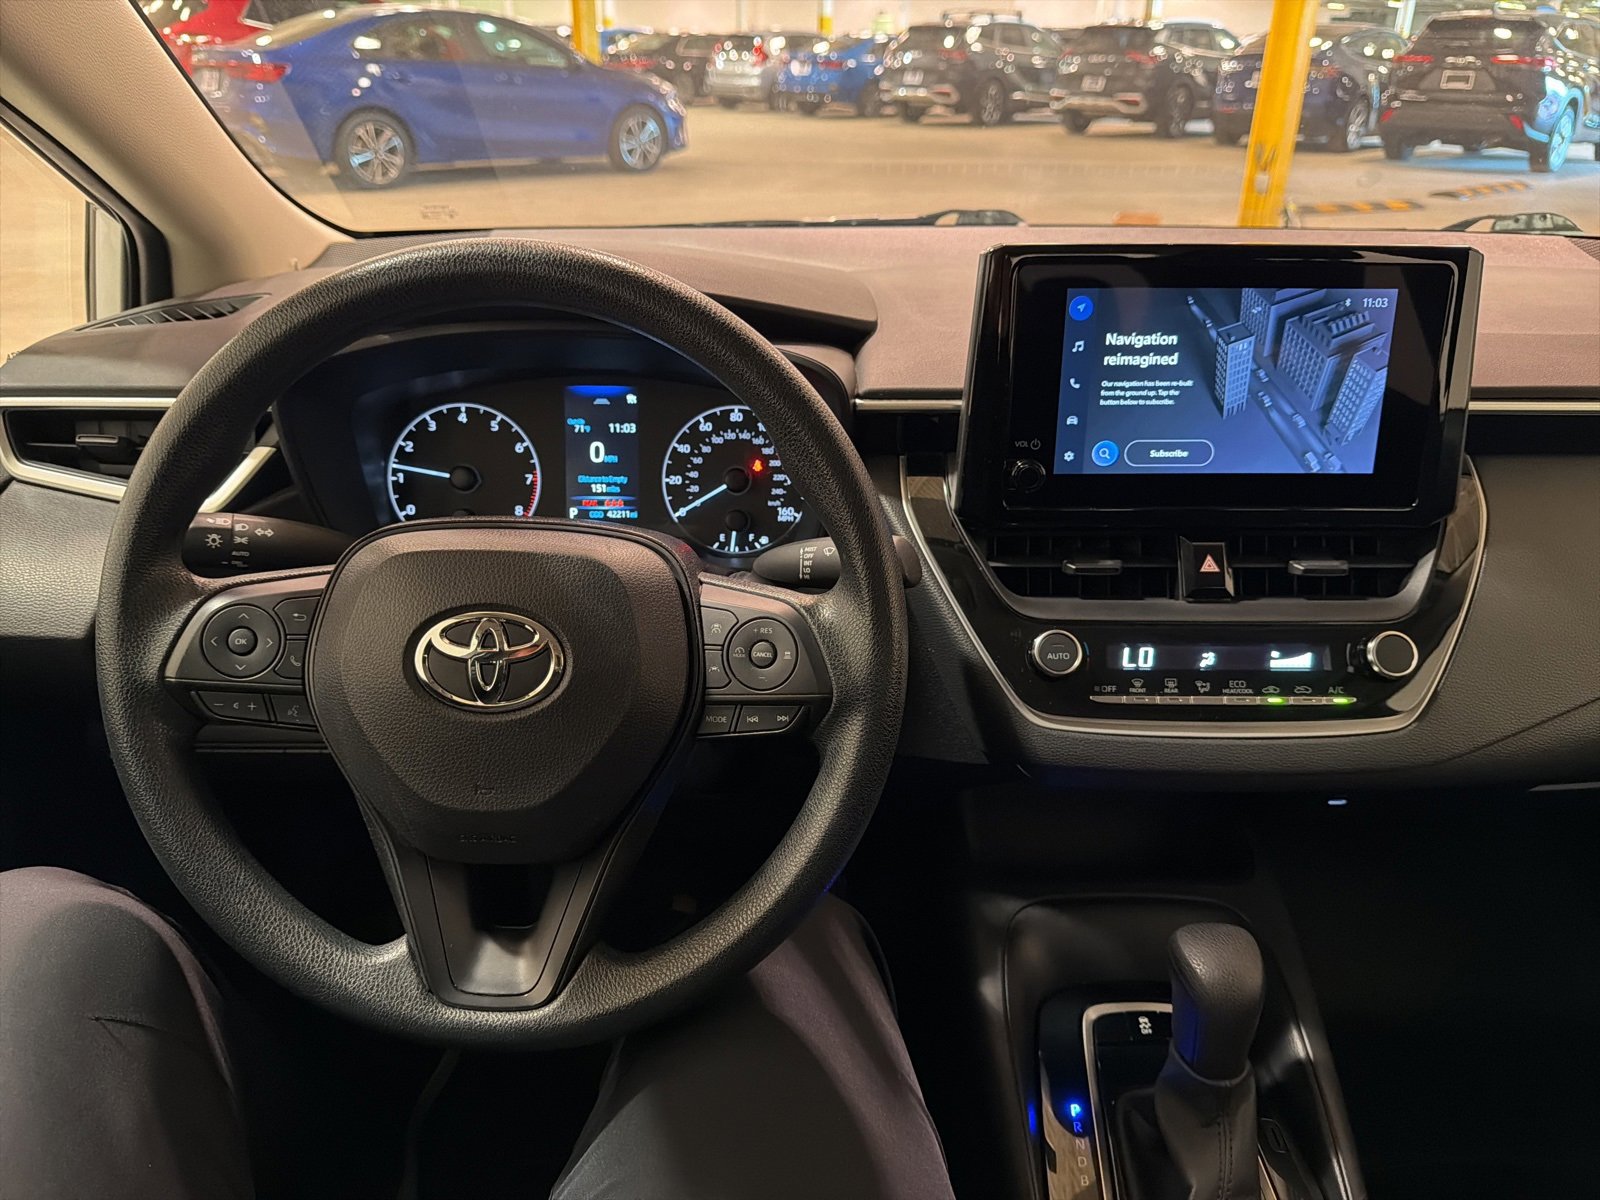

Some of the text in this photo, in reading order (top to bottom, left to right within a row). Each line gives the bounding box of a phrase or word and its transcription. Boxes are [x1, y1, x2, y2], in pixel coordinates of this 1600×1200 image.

[1362, 298, 1388, 308] 11:03
[1105, 332, 1178, 348] Navigation
[1104, 352, 1179, 368] reimagined
[1114, 380, 1144, 388] navigation
[1125, 389, 1147, 397] ground
[457, 412, 468, 423] 4
[729, 412, 743, 422] 80
[427, 420, 437, 431] 3
[490, 420, 499, 431] 5
[608, 423, 637, 433] 11:03
[699, 422, 712, 432] 60
[404, 441, 414, 452] 2
[514, 442, 524, 453] 6
[677, 444, 690, 453] 40
[589, 441, 605, 463] 0
[1150, 449, 1189, 458] Subscribe
[396, 472, 404, 484] 1
[524, 474, 533, 485] 7
[669, 475, 682, 485] 20
[590, 484, 606, 493] 151
[406, 505, 416, 515] 0
[514, 505, 524, 516] 8
[569, 507, 578, 519] P
[606, 510, 630, 518] 42211
[777, 507, 795, 516] 160
[1122, 646, 1154, 668] LO
[1228, 680, 1246, 688] ECO
[1070, 1103, 1082, 1117] P
[1073, 1121, 1082, 1133] R
[1076, 1139, 1085, 1149] N
[1078, 1157, 1087, 1167] D
[1081, 1176, 1089, 1186] B
